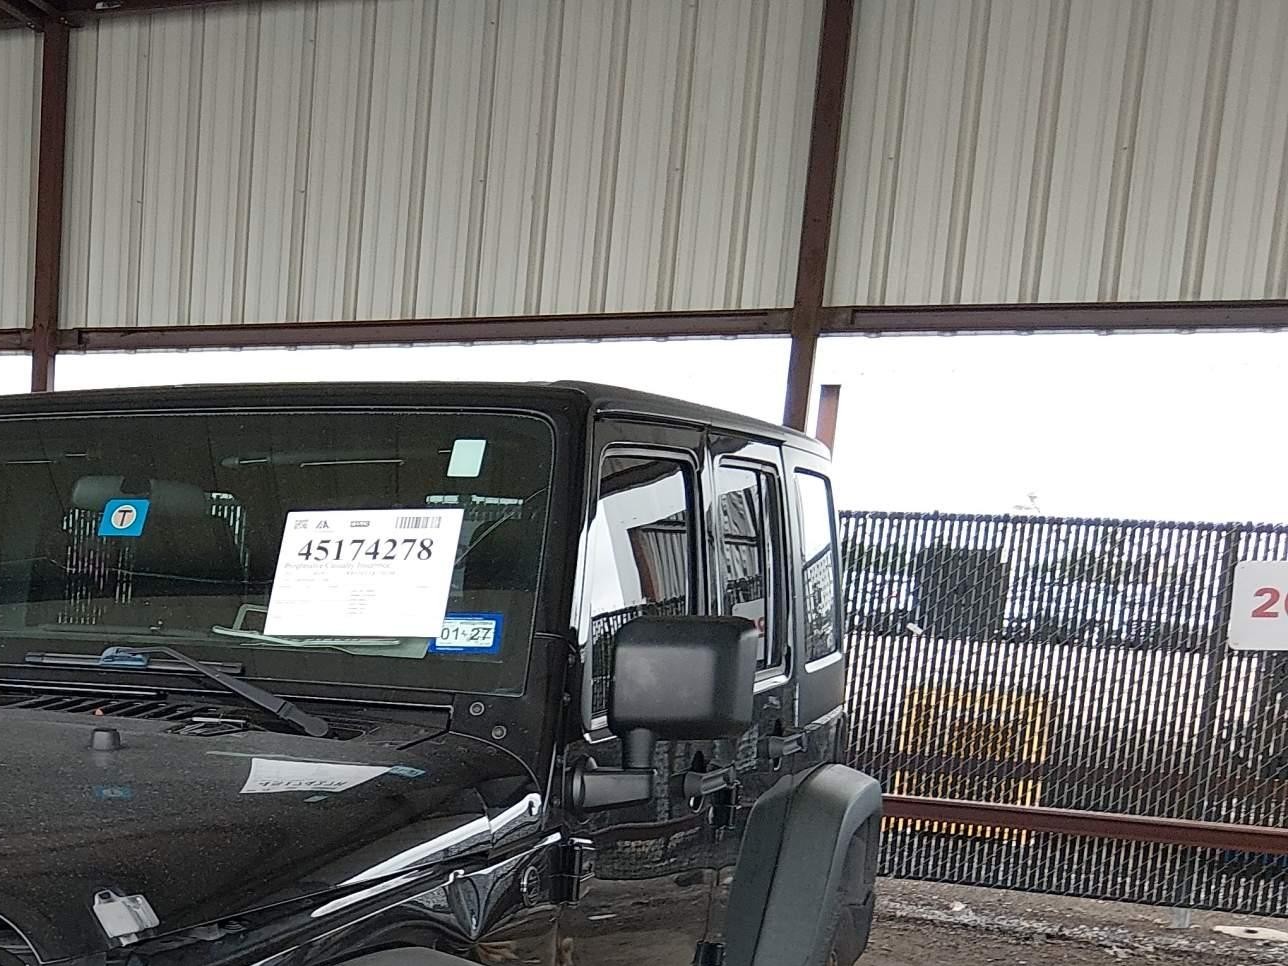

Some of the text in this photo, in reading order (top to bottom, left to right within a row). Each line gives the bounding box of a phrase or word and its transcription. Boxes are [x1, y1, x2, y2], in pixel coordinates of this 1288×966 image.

[117, 508, 134, 527] T
[298, 537, 434, 561] 45174278
[440, 626, 493, 641] 01 27
